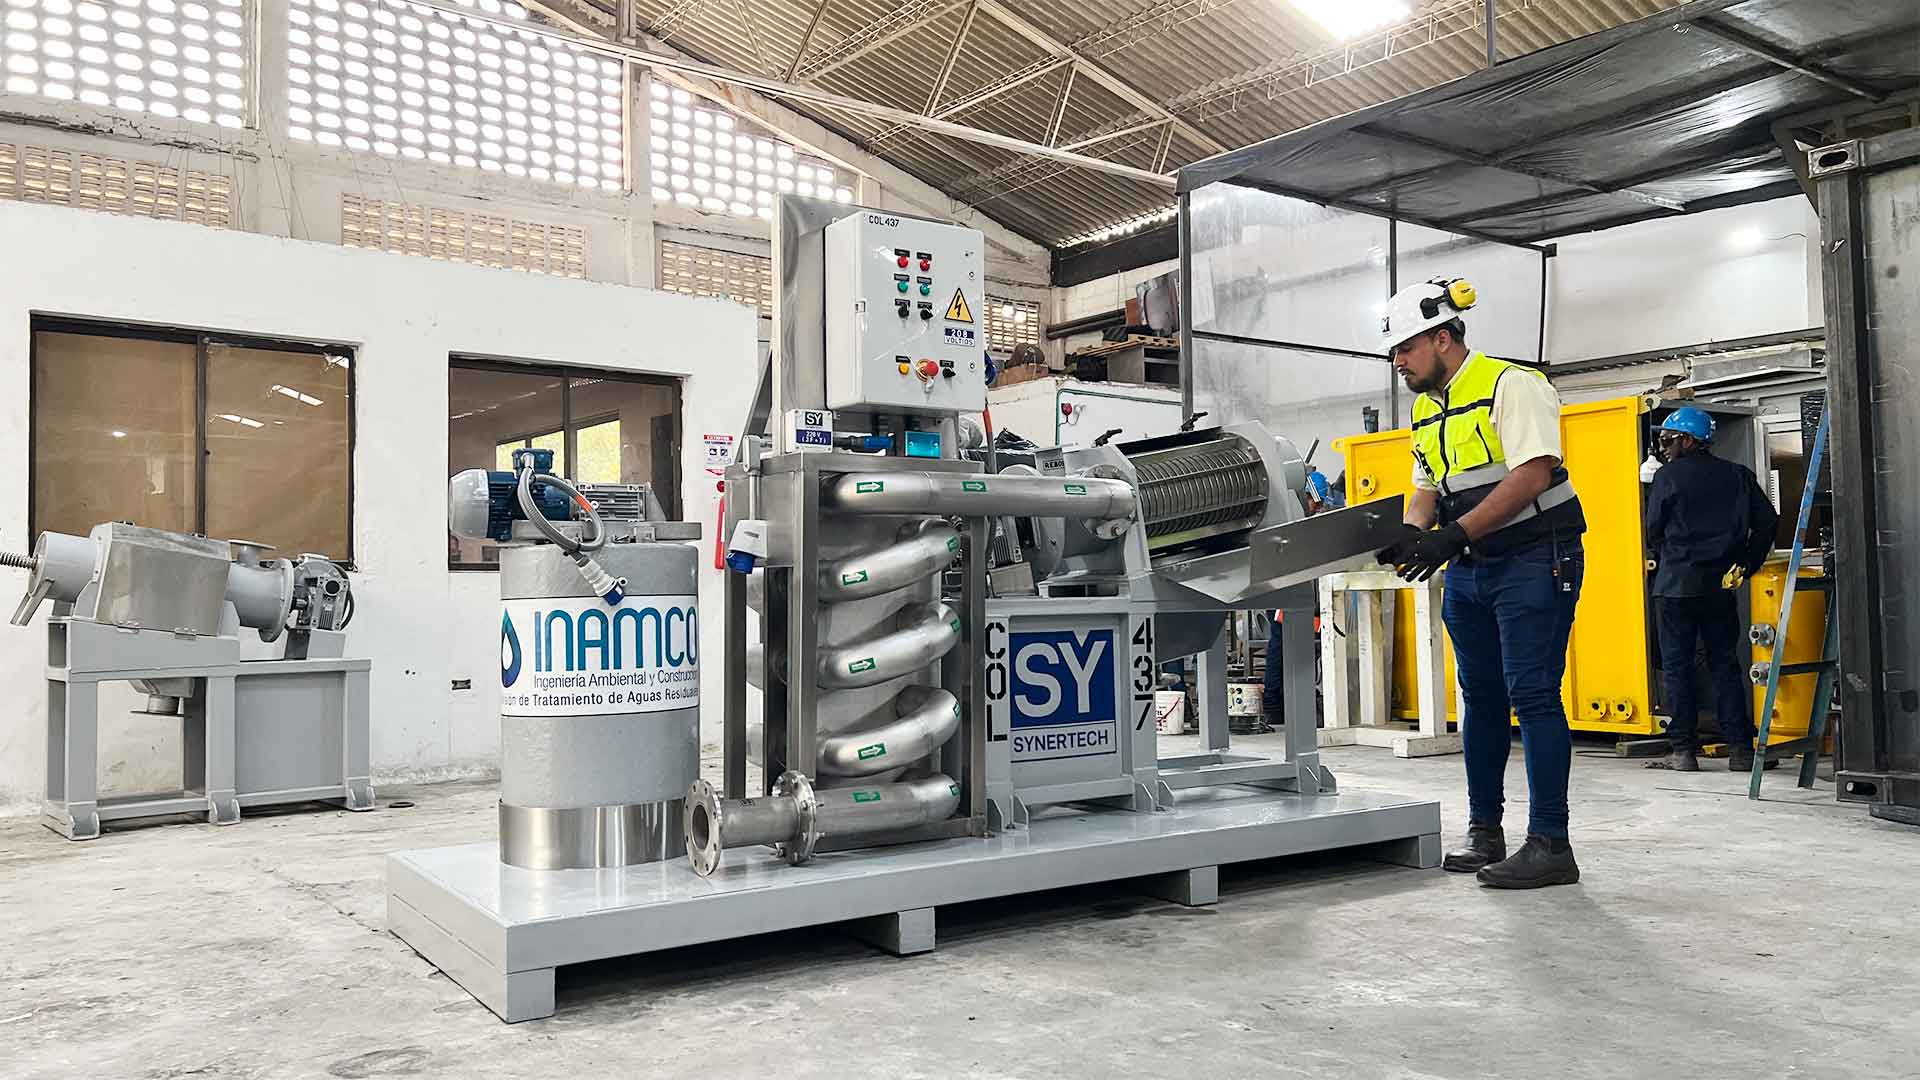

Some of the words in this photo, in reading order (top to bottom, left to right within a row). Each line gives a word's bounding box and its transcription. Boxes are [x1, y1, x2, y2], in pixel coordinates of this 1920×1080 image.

[806, 412, 822, 425] SY
[534, 606, 698, 672] INAMCO
[534, 674, 586, 691] Ingeniería
[588, 671, 646, 688] Ambiental
[648, 674, 655, 687] y
[1014, 640, 1107, 718] SY
[519, 694, 529, 706] de
[533, 693, 603, 706] Tratamiento
[608, 691, 623, 704] de
[627, 690, 662, 705] Aguas
[1013, 730, 1108, 753] SYNERTECH
